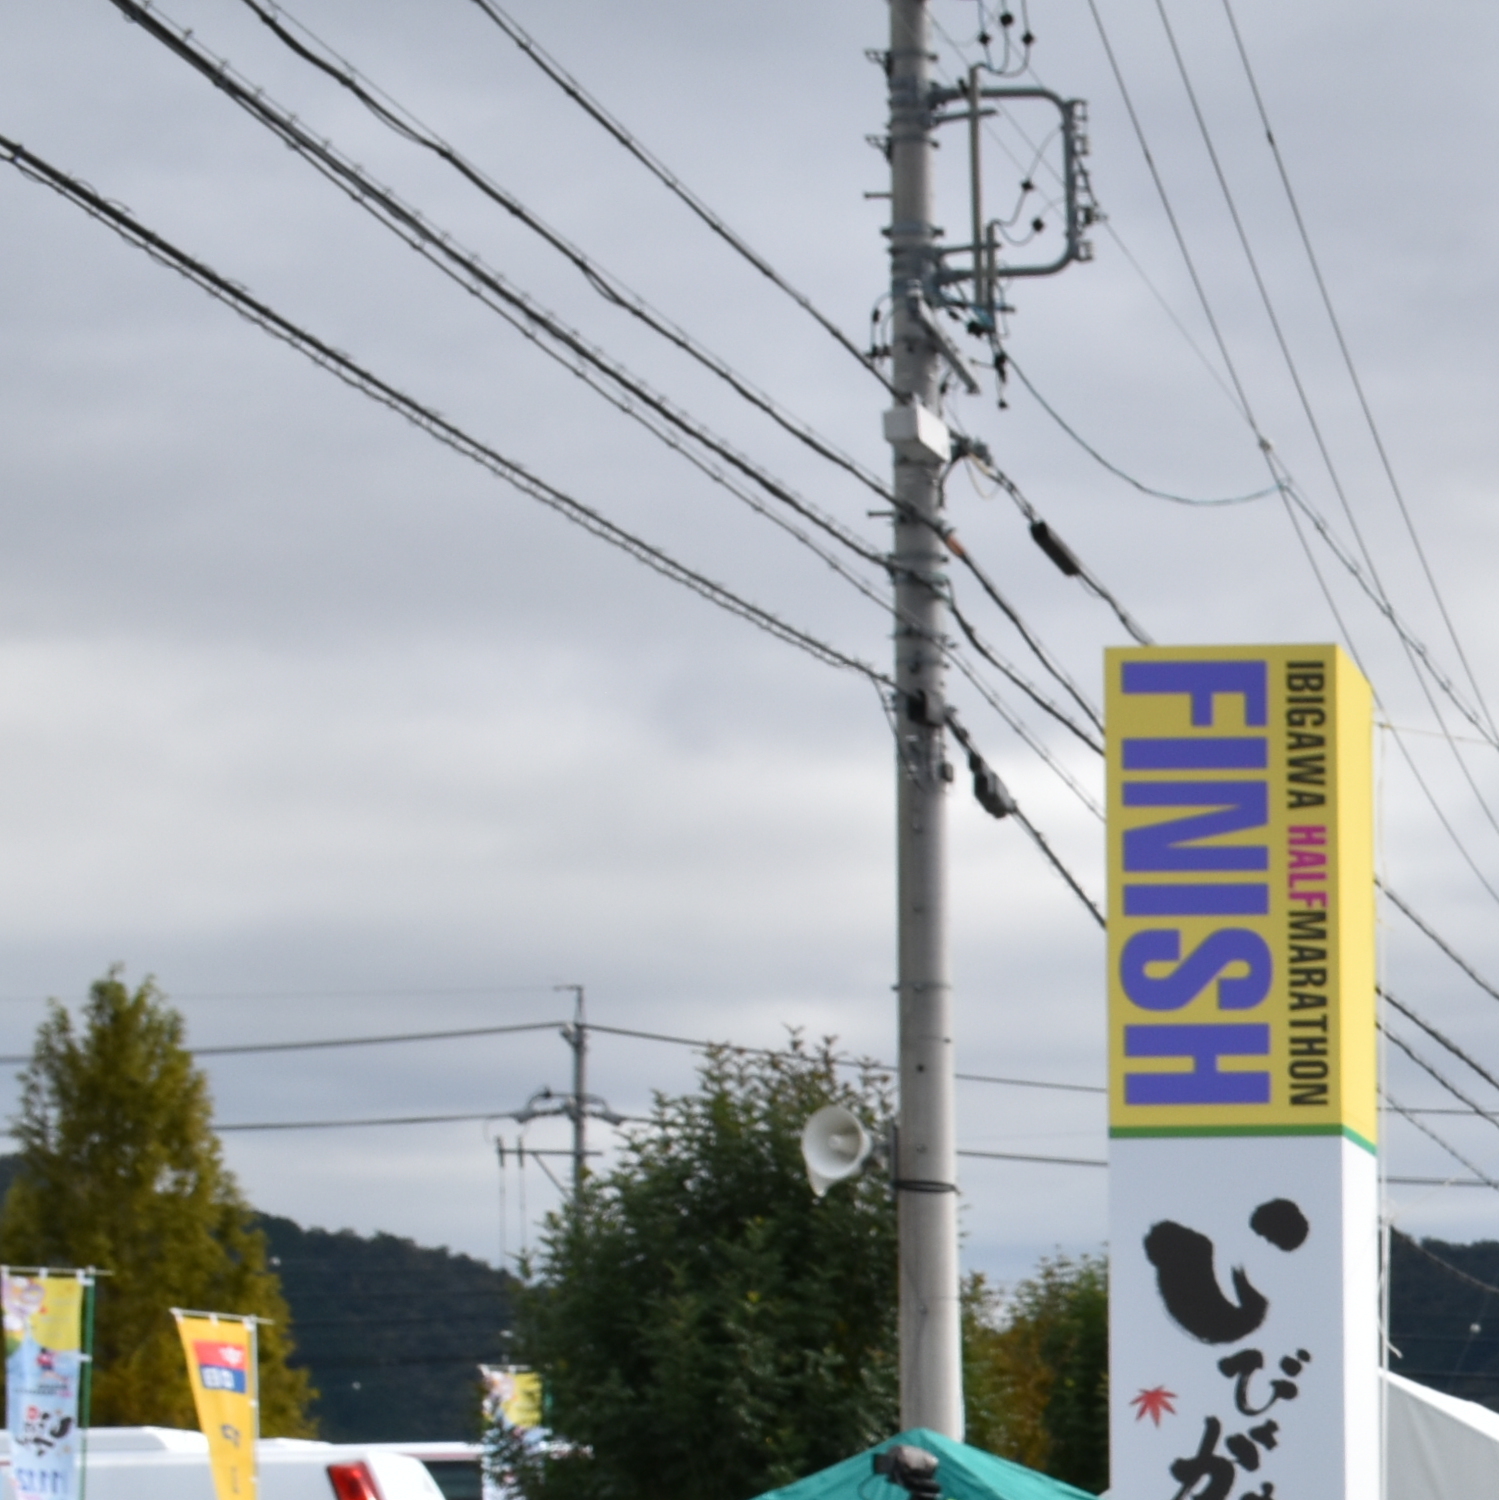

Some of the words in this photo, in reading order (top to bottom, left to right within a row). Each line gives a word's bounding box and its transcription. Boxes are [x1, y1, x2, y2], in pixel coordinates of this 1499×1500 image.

[1285, 661, 1327, 810] IBIGAWA
[1119, 660, 1273, 1106] FINISH
[1287, 825, 1329, 908] HALF
[1287, 910, 1329, 1107] MARATHON
